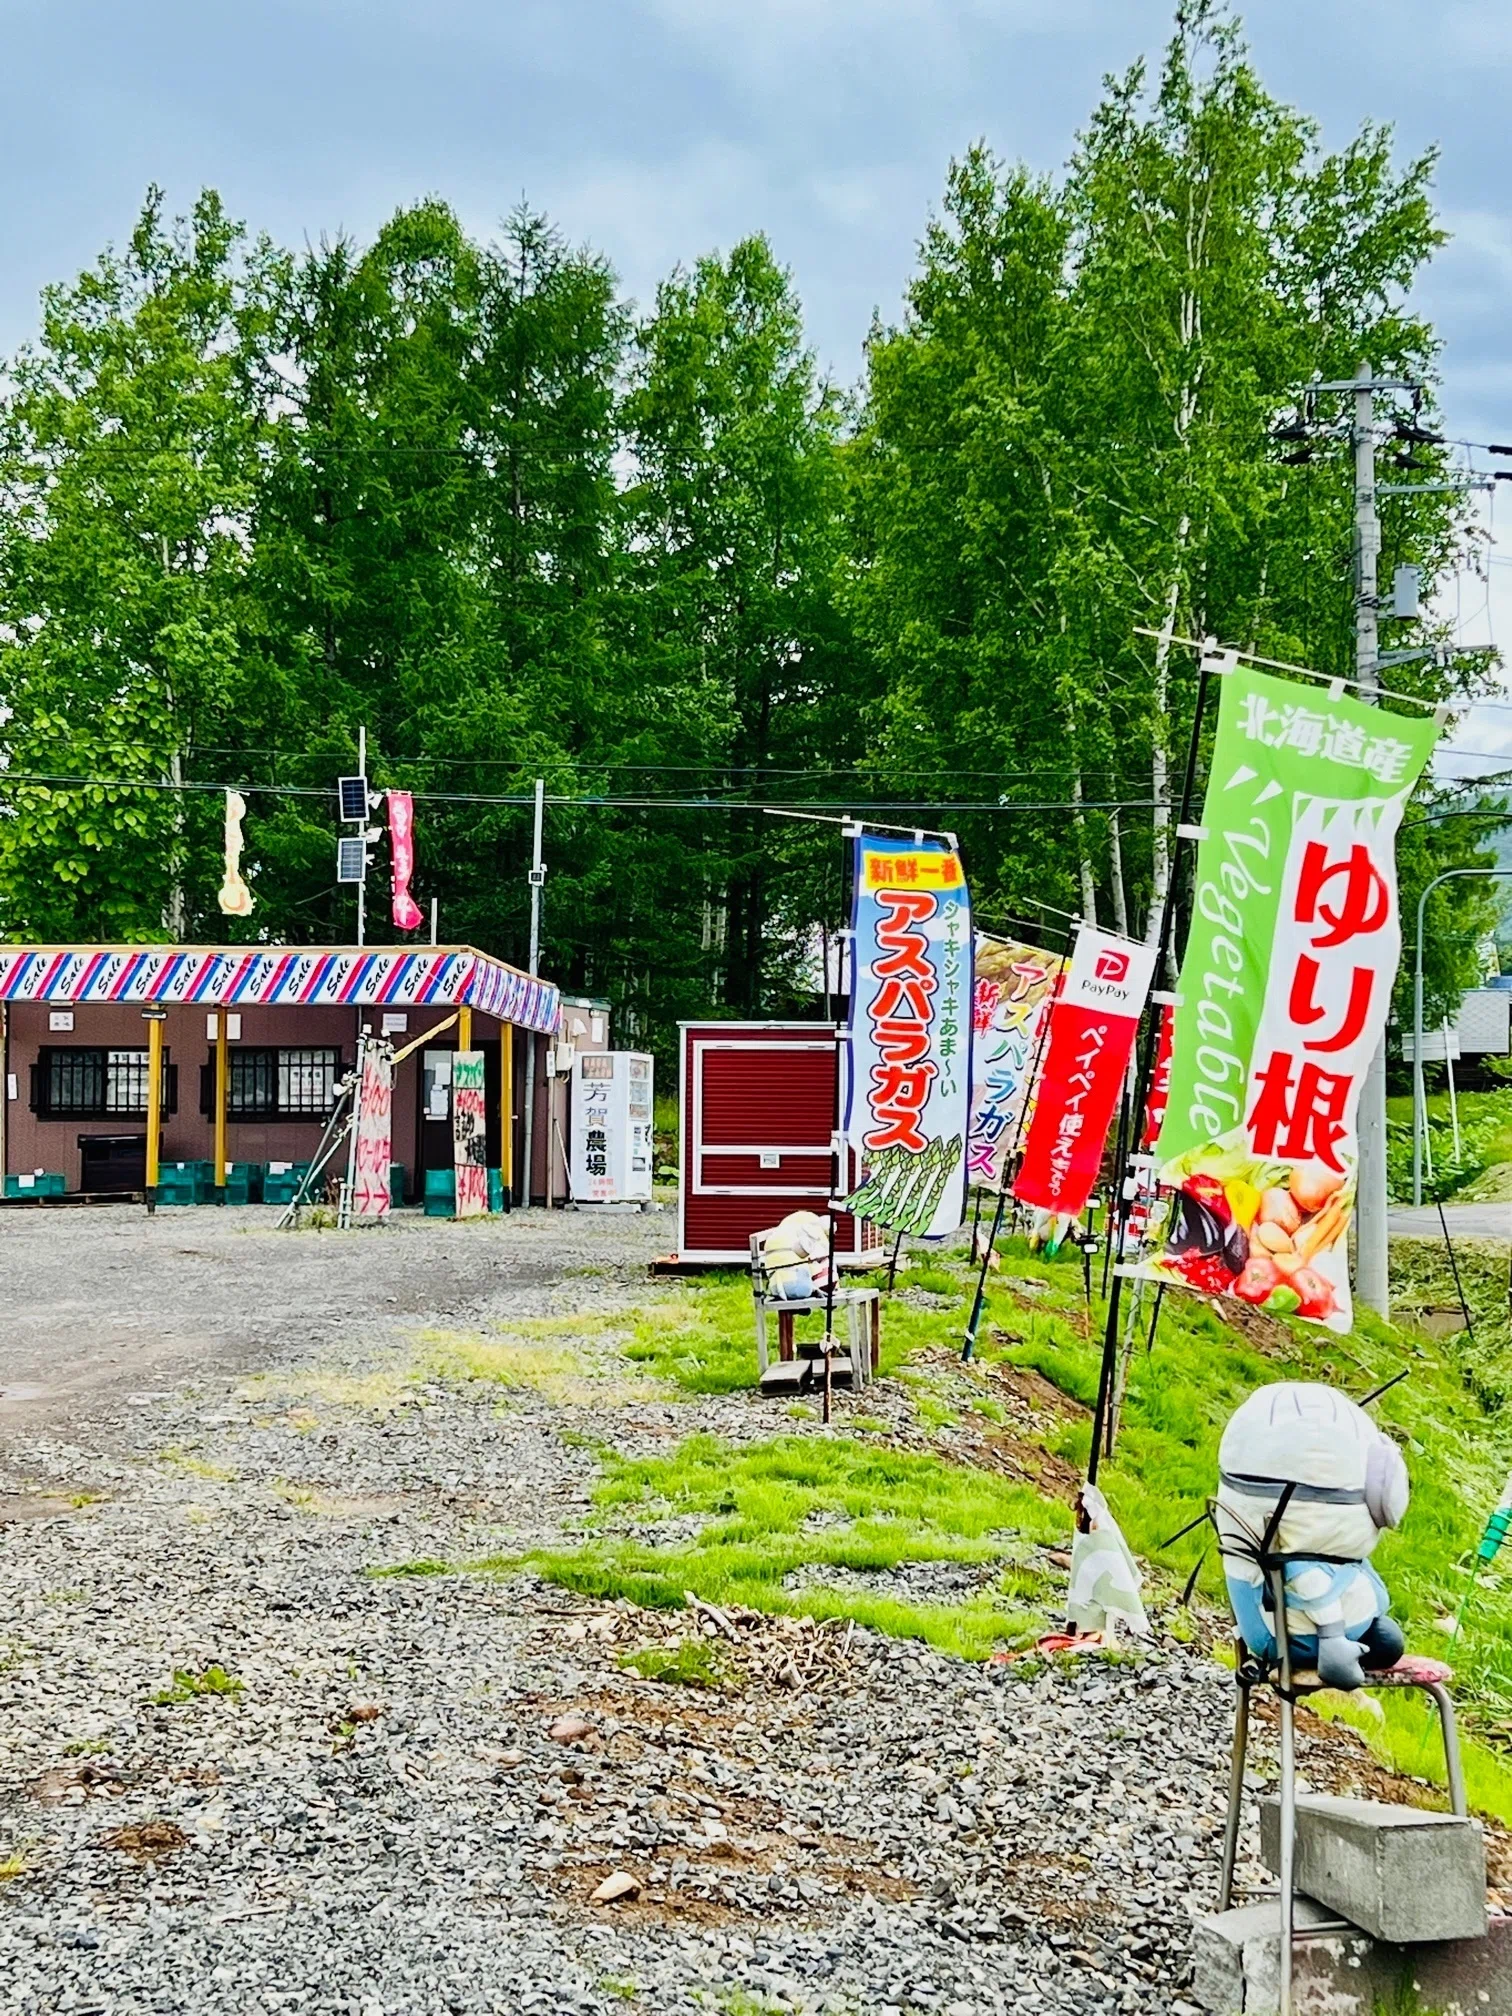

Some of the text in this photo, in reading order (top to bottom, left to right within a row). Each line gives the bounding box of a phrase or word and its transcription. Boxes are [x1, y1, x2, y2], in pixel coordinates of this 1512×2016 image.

[1237, 693, 1413, 783] 北海道産
[869, 857, 959, 883] 新鮮一番
[23, 958, 48, 995] Sale
[60, 957, 85, 995] Sale
[98, 957, 123, 996] Sale
[135, 957, 161, 996] Sale
[173, 957, 199, 996] Sale
[211, 957, 236, 996] Sale
[249, 958, 275, 996] Sale
[288, 958, 313, 997] Sale
[326, 958, 351, 997] Sale
[365, 958, 391, 997] Sale
[404, 958, 429, 998] Sale
[442, 959, 468, 998] Sale
[1082, 979, 1130, 1001] PayPay
[1189, 817, 1272, 1137] Vegetable
[865, 890, 938, 1152] アスパラガス
[1247, 840, 1390, 1173] ゆり根
[968, 963, 1047, 1180] アスパラガス
[583, 1082, 612, 1177] 芳賀農場
